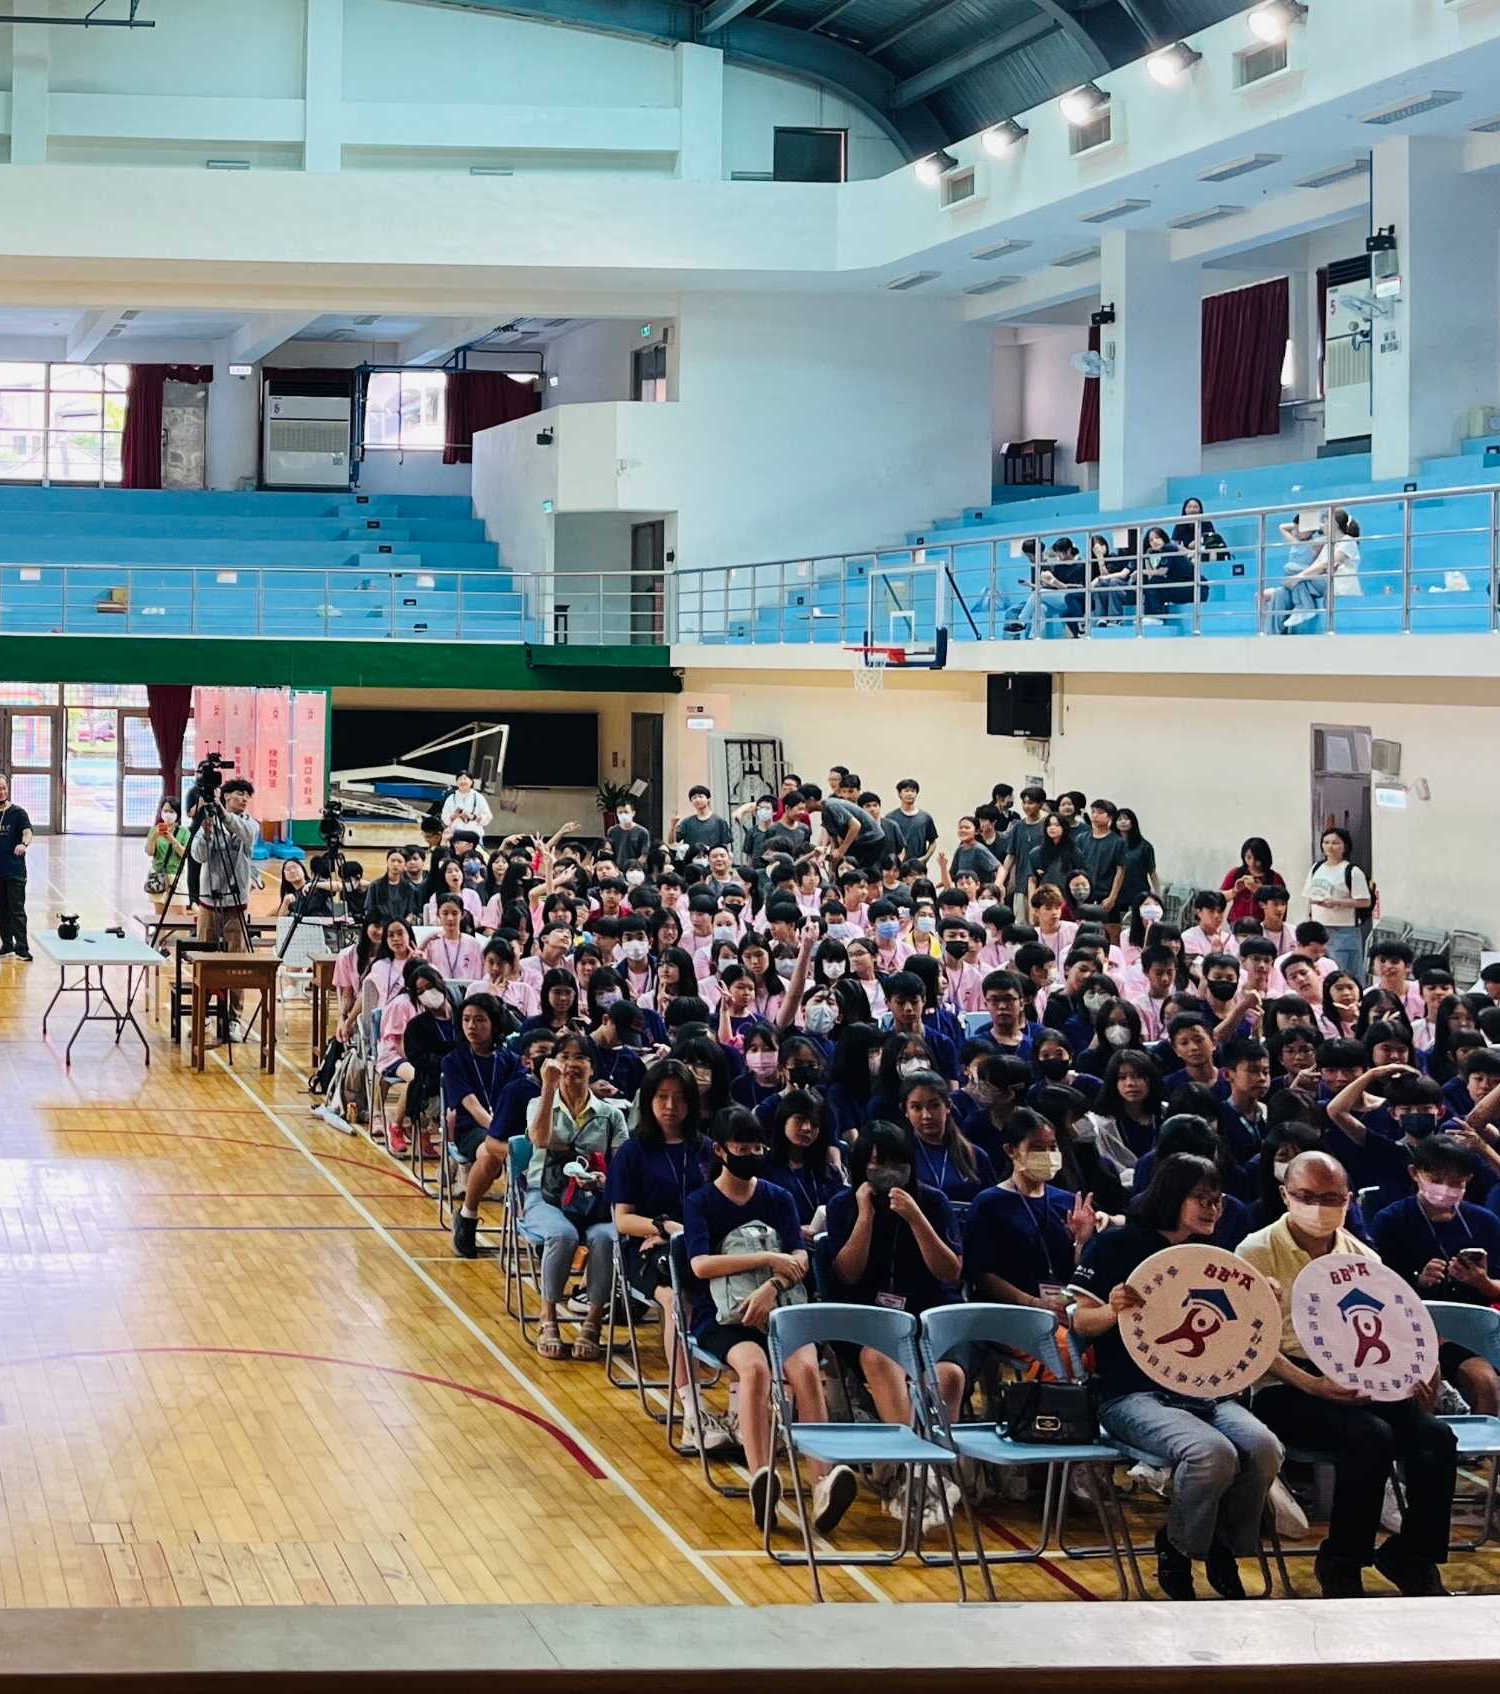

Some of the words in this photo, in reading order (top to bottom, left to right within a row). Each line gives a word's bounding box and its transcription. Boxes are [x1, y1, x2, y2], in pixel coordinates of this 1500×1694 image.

[1330, 299, 1336, 315] 5
[268, 749, 278, 788] 快問快答
